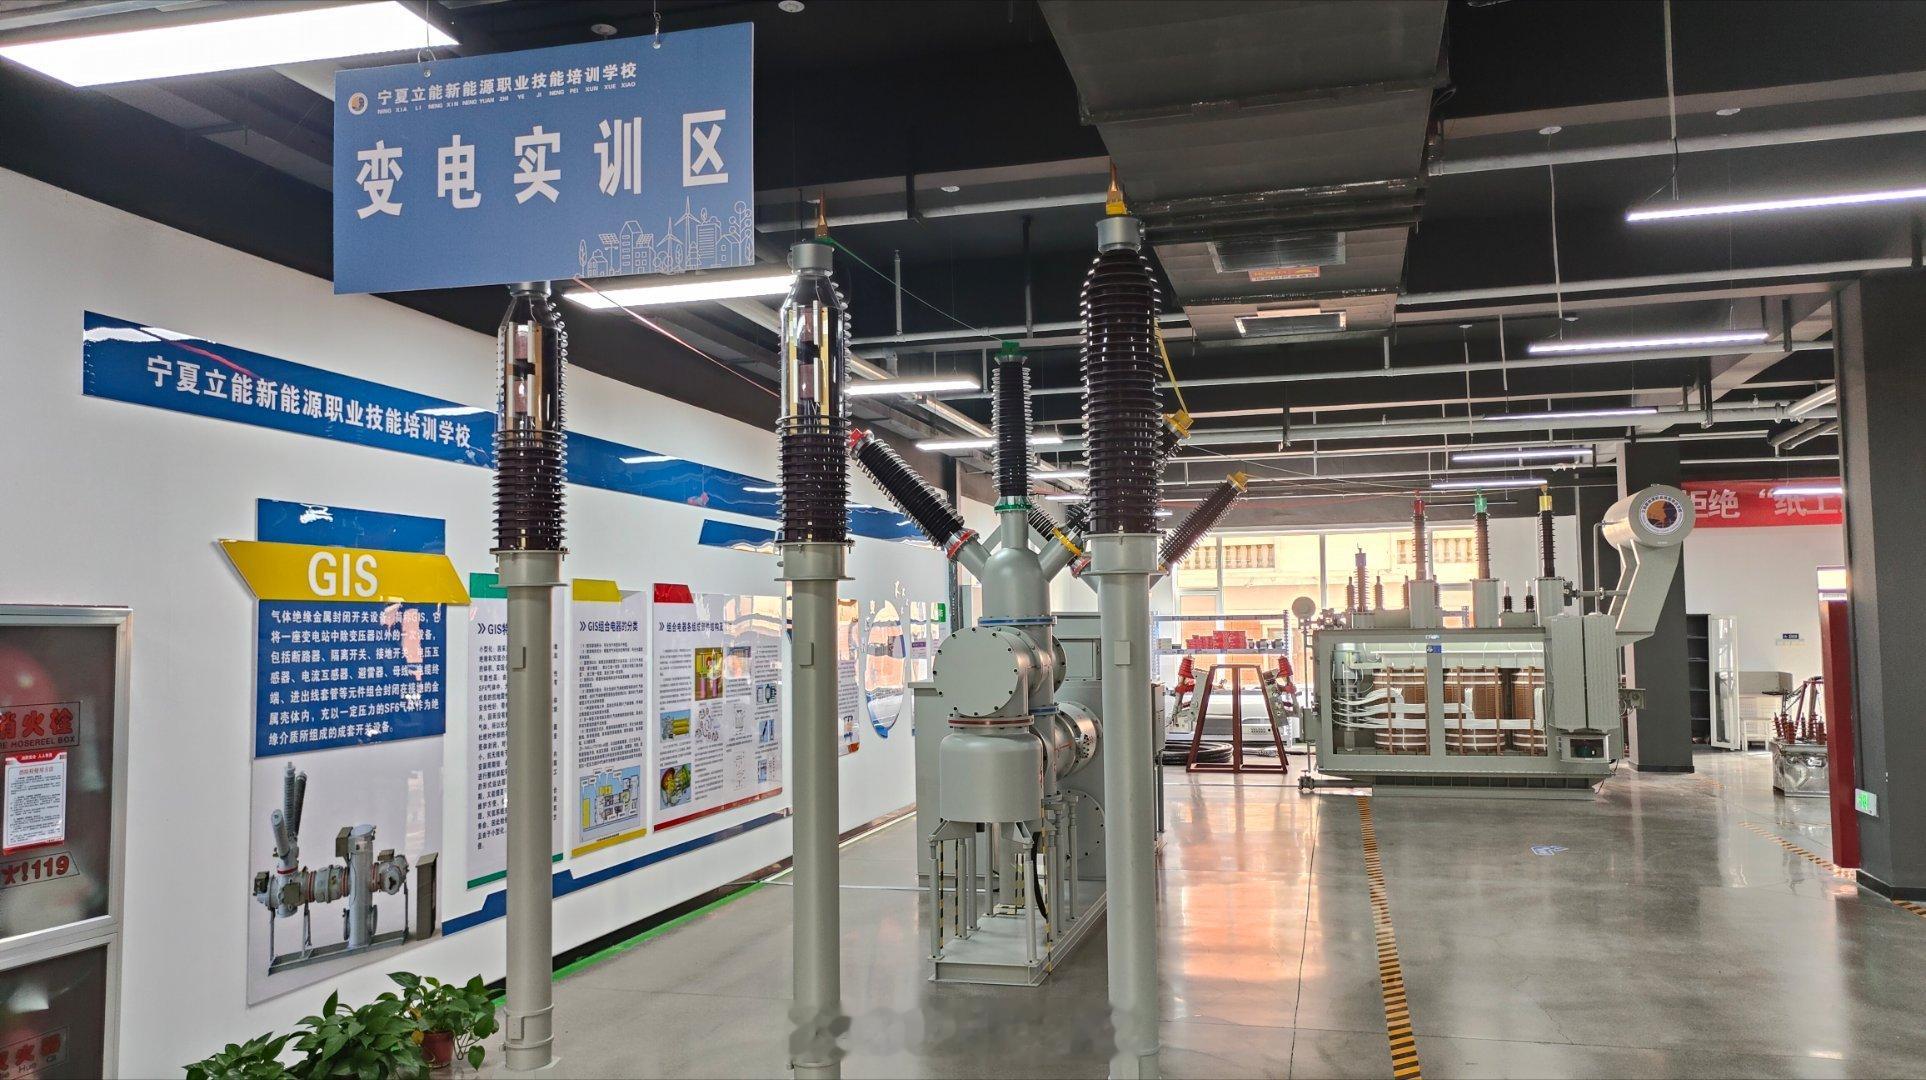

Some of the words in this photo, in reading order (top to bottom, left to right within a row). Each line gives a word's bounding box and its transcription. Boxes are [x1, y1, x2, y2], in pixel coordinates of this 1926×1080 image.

[377, 62, 637, 105] 宁夏立能新能源职业技能培训学校
[355, 109, 730, 219] 变电实训区
[146, 355, 471, 448] 宁夏立能新能源职业技能培训学校
[308, 551, 378, 597] GIS
[269, 664, 440, 685] 感器、电流互感器、避雷器、母线电缆终
[270, 647, 440, 664] 包括断路器、隔离开关、接地开关电压互
[11, 738, 55, 748] HOSEREEL
[58, 735, 75, 744] BOX
